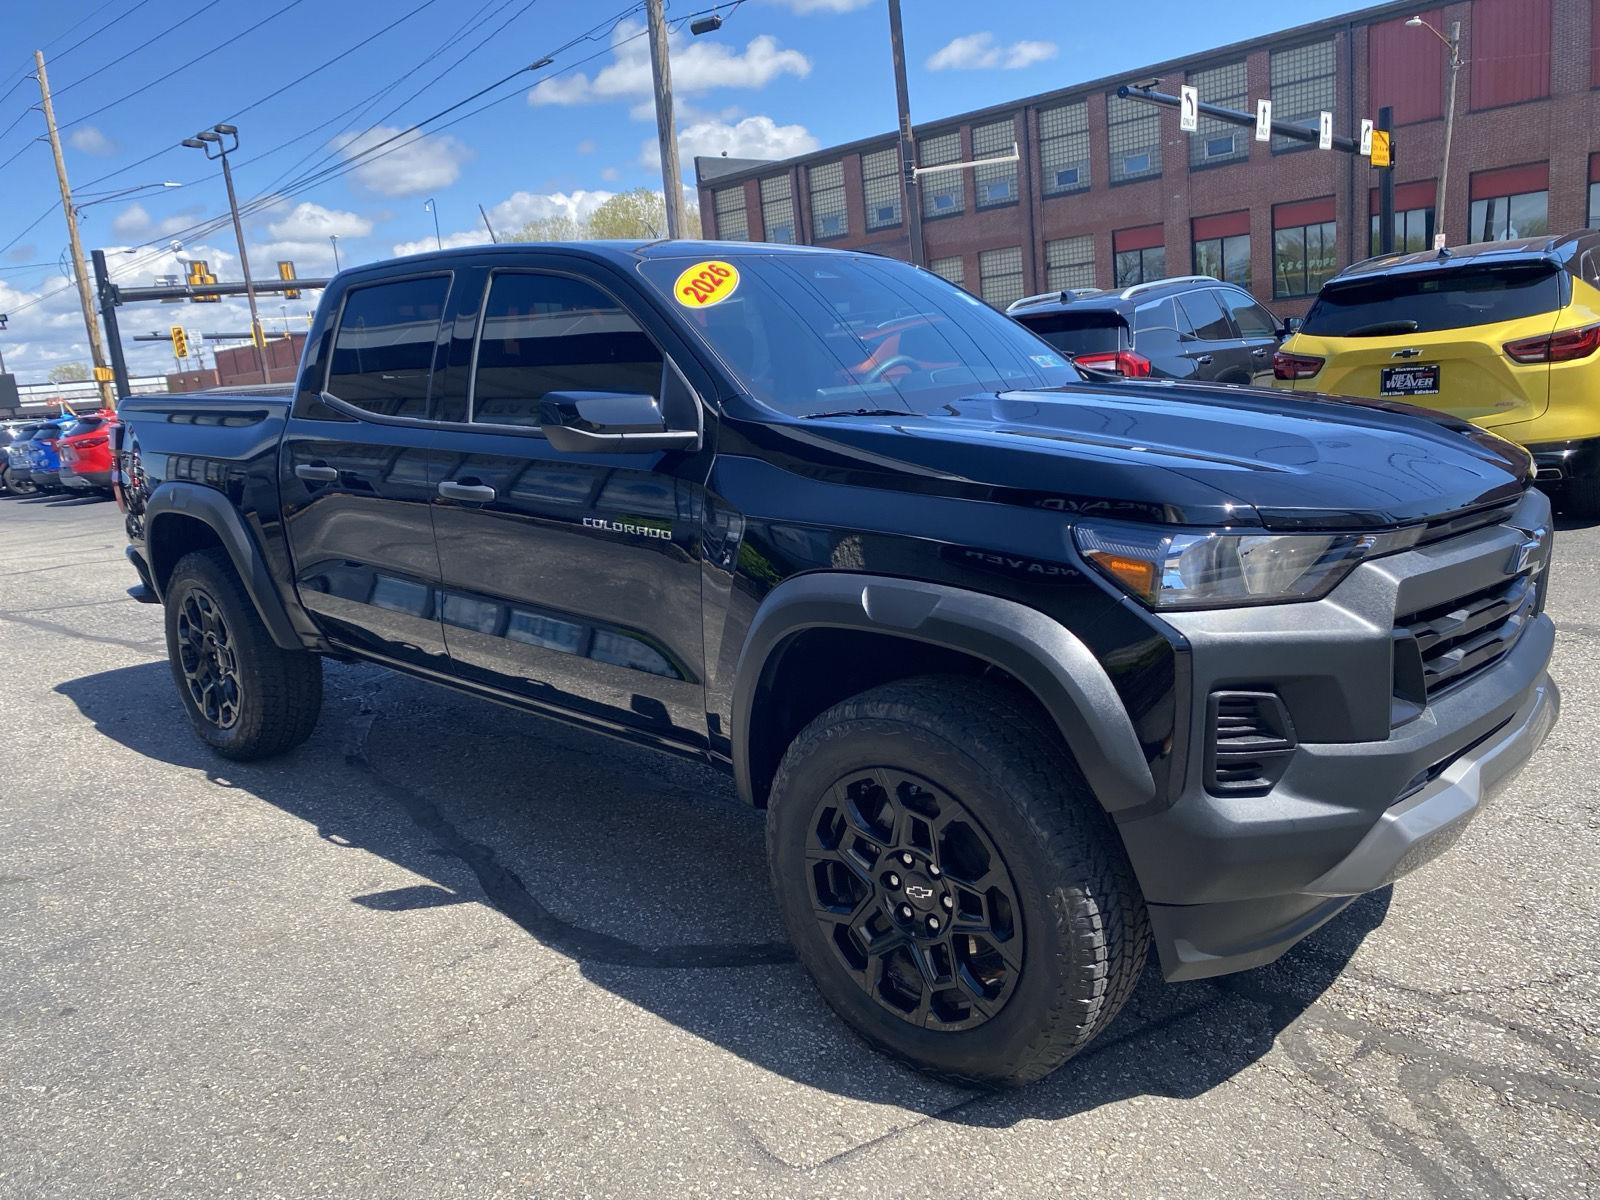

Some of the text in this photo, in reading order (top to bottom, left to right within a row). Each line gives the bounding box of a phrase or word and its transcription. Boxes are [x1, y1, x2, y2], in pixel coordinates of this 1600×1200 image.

[1182, 117, 1195, 127] ONLY
[683, 264, 730, 304] 2026
[1391, 373, 1414, 381] RICK
[1386, 378, 1434, 388] WEAVER
[582, 517, 672, 540] COLORADO
